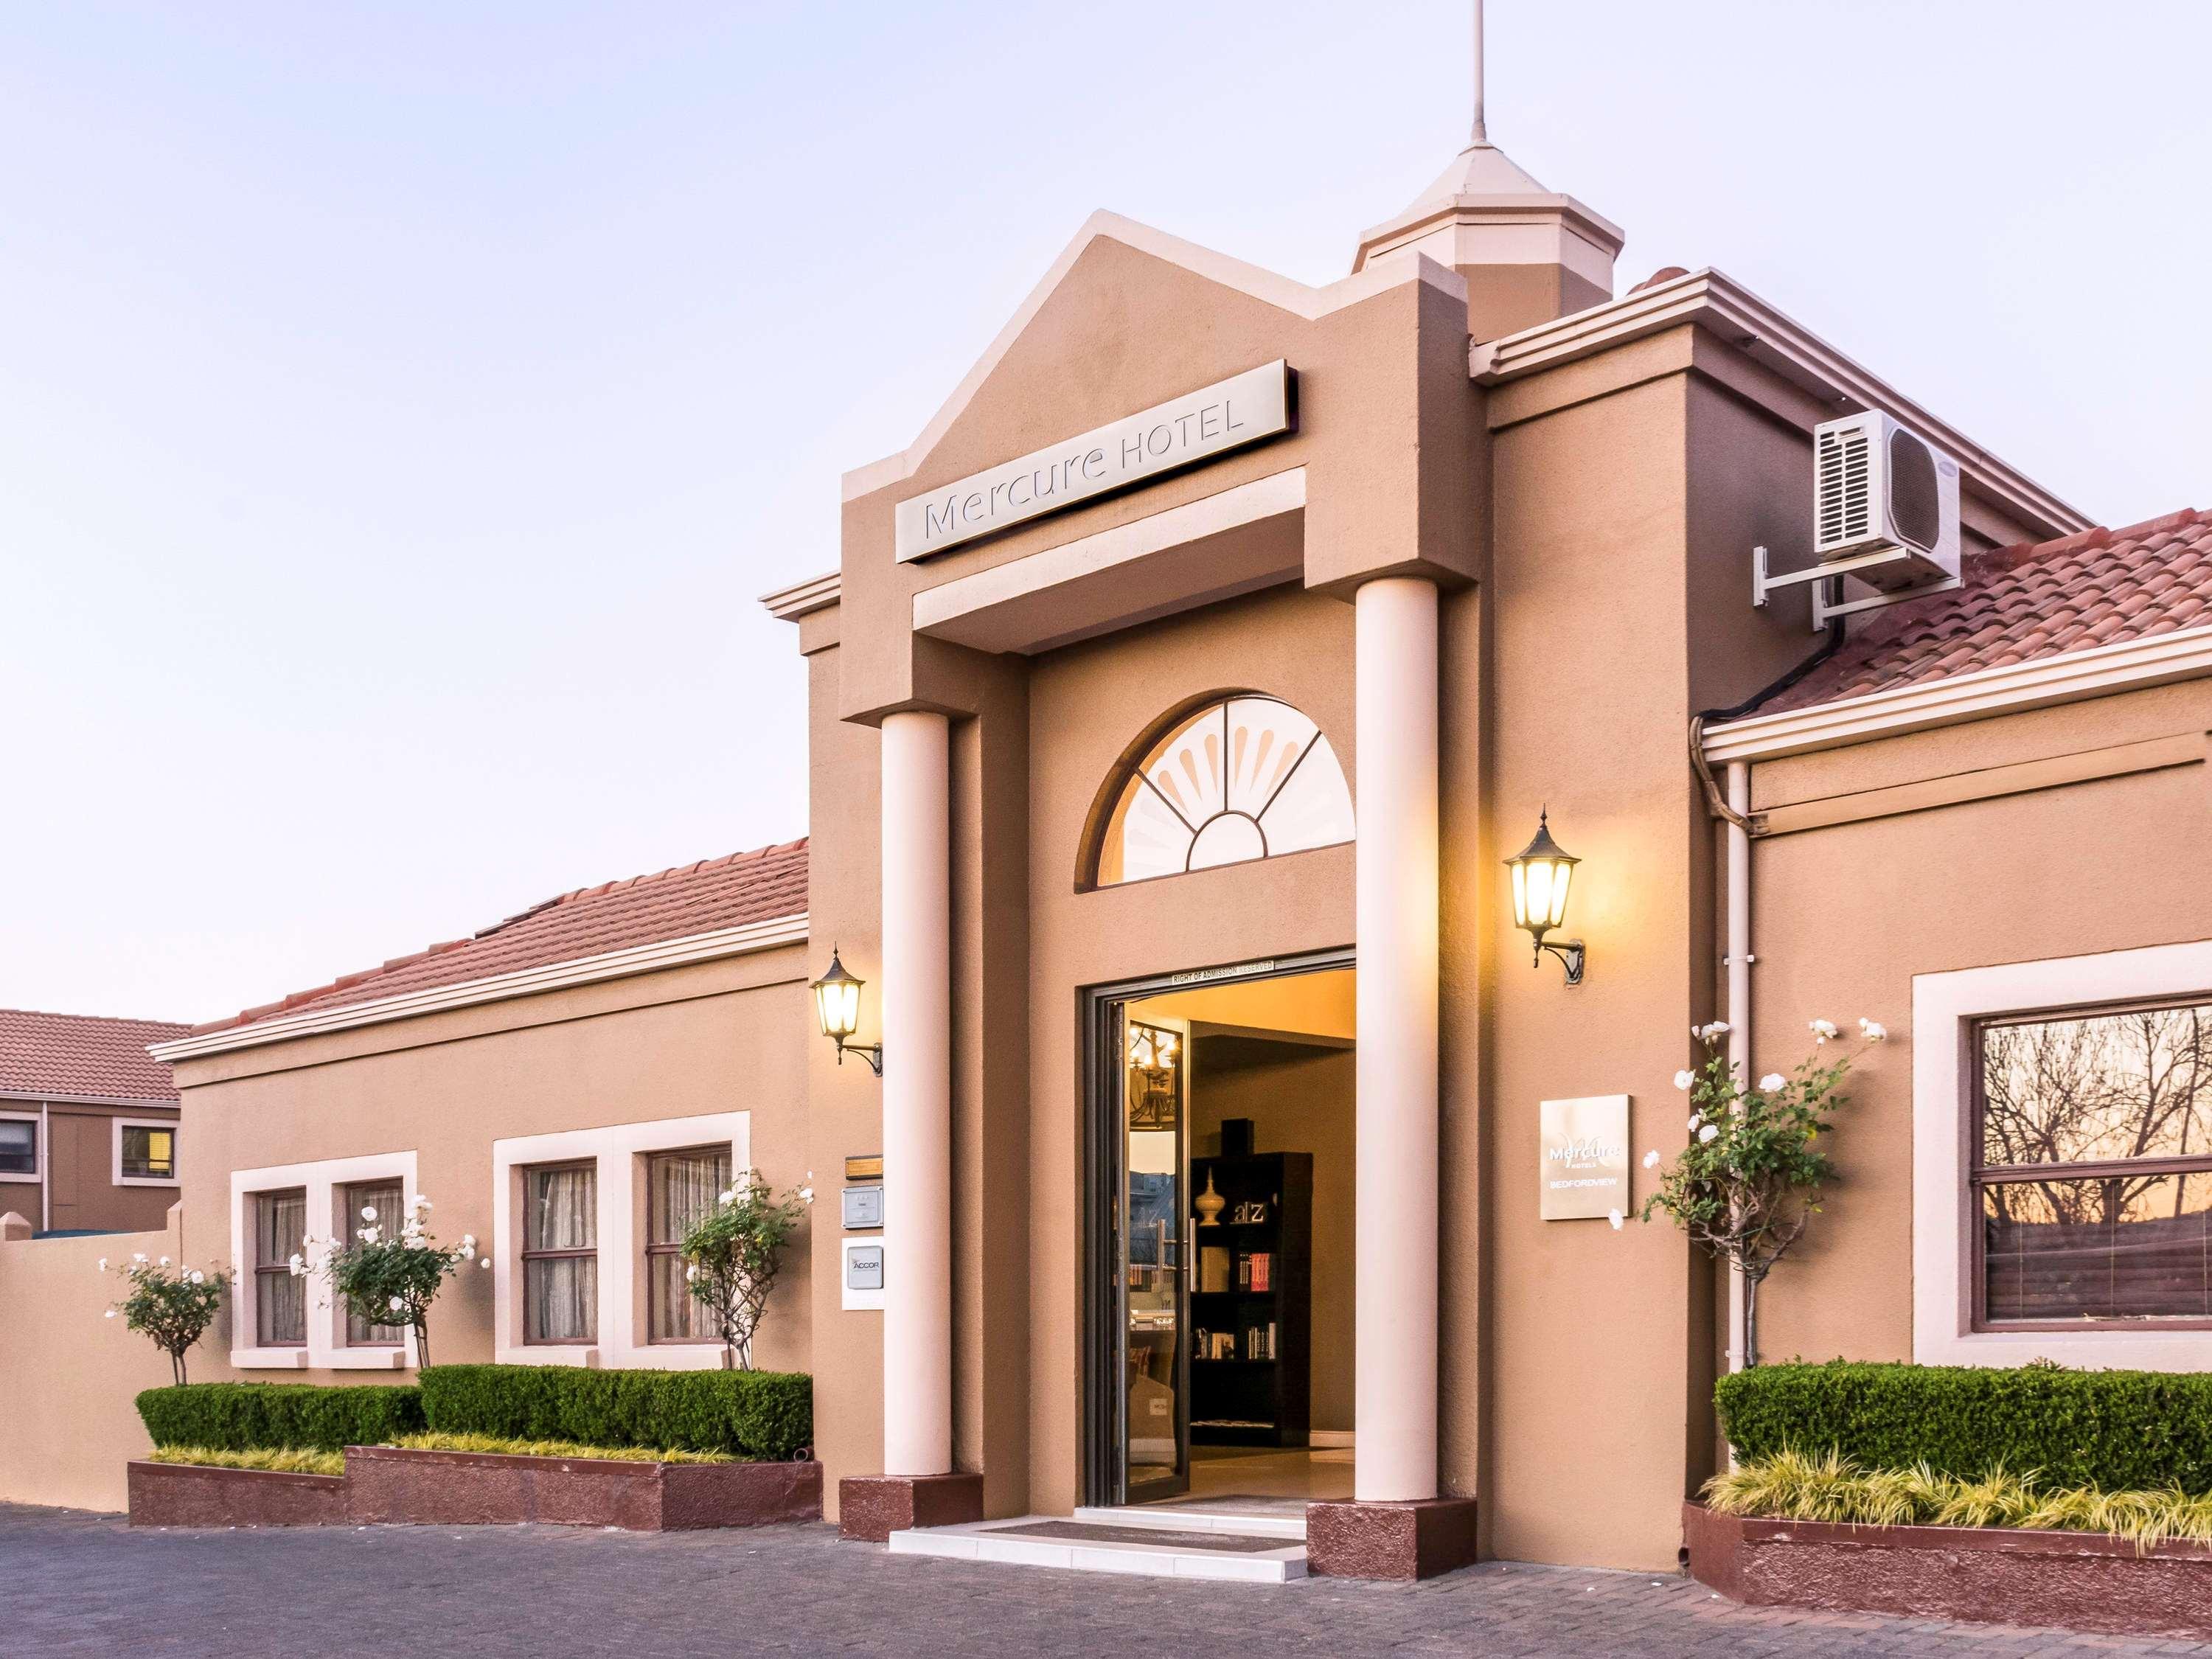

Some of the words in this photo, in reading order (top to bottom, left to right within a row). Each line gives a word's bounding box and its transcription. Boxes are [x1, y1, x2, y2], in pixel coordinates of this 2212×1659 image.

[925, 447, 1106, 539] Mercure
[1121, 400, 1244, 469] HOTEL
[1173, 974, 1192, 983] RIGHT
[1194, 972, 1202, 981] OF
[1203, 967, 1237, 979] ADMISSION
[1550, 1178, 1617, 1189] BEDFORDVIEW
